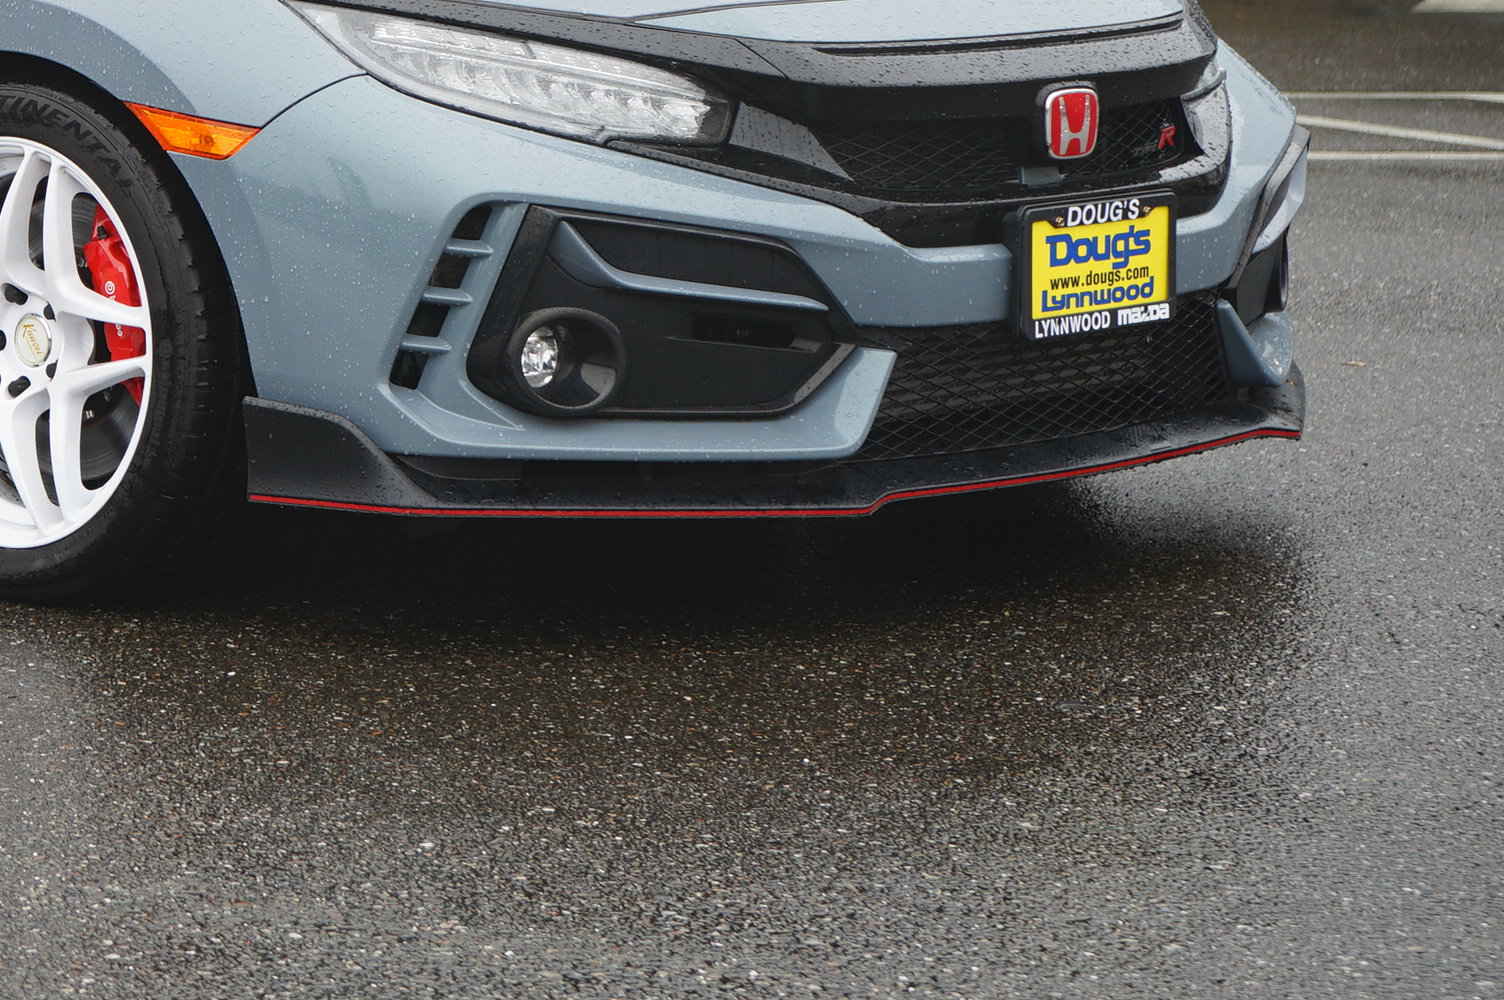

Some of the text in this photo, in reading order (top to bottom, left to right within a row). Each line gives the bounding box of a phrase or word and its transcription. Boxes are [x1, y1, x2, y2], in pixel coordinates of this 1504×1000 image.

[1157, 125, 1176, 149] R
[1066, 198, 1140, 228] DOUG'S
[1050, 266, 1150, 290] www.dougs.com
[1041, 275, 1155, 313] Lynnwood
[1034, 311, 1111, 339] LYNNWOOD
